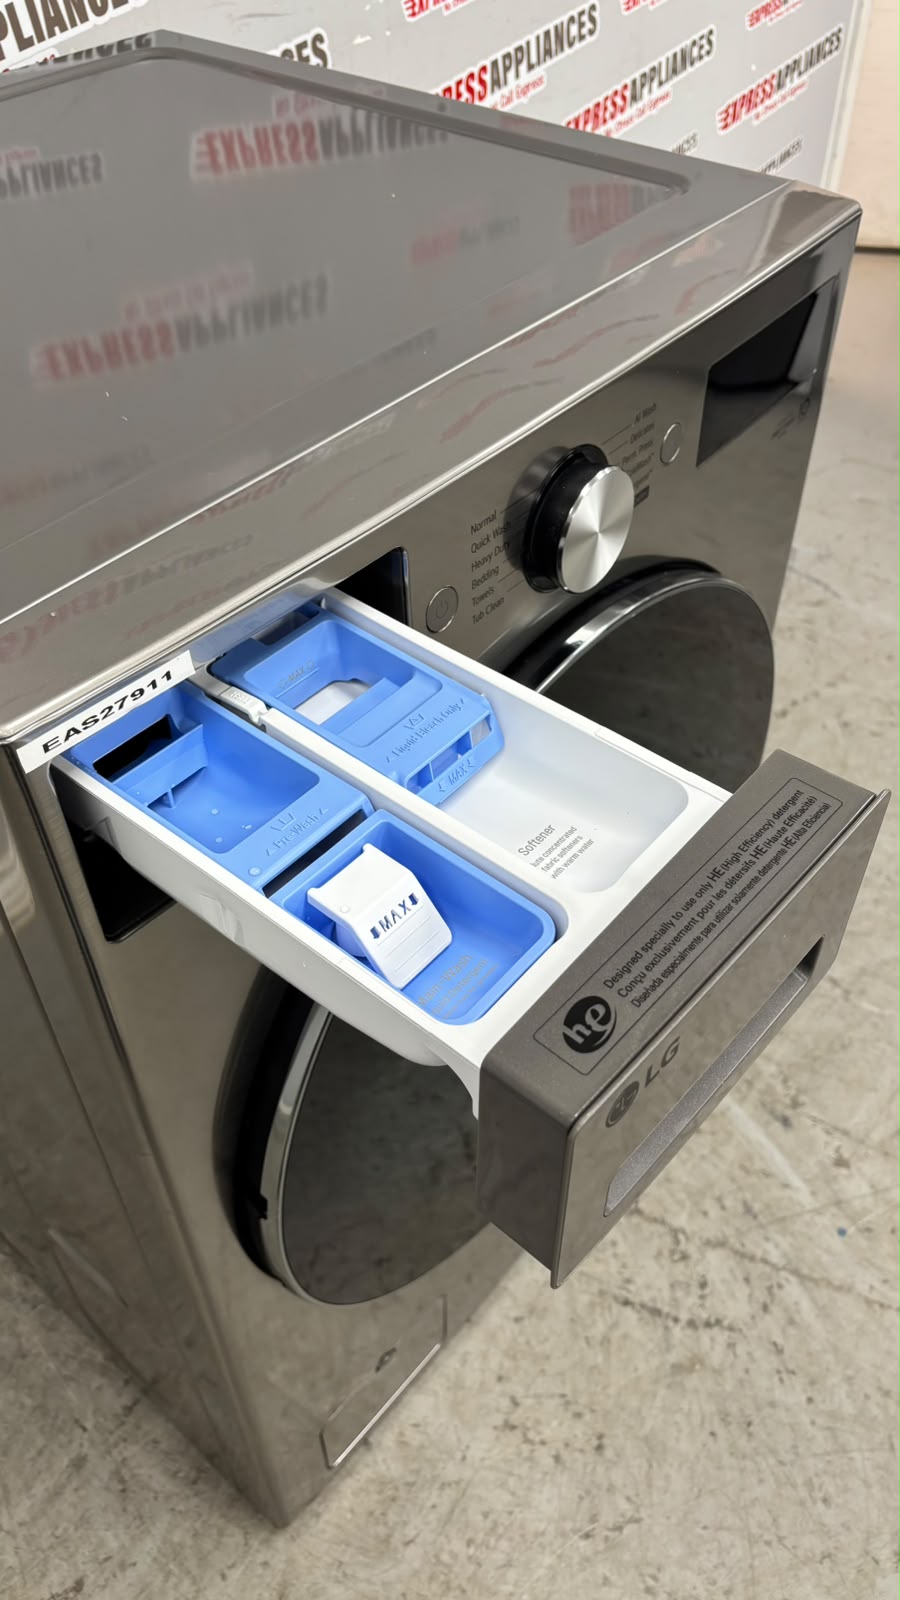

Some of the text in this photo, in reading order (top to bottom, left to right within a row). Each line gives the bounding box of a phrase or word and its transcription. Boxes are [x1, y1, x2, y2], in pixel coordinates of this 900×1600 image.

[470, 509, 497, 535] Normal
[471, 521, 511, 554] Quick Wash
[471, 552, 493, 573] Heavy
[471, 565, 499, 590] Bedding
[471, 585, 495, 607] Towels
[472, 597, 505, 624] Tub Clean
[42, 670, 173, 754] EAS27911
[415, 717, 444, 738] Bleach
[440, 702, 461, 718] Only
[447, 763, 468, 785] MAX
[272, 815, 319, 849] Pre-Wash
[518, 824, 556, 856] Softener
[542, 826, 578, 858] concentrated
[541, 835, 584, 872] fabric softeners
[551, 838, 595, 879] with warm water
[603, 950, 643, 989] Designed
[641, 919, 676, 953] specially
[671, 911, 684, 921] to
[681, 897, 698, 912] use
[695, 881, 714, 899] only
[738, 818, 776, 853] Efficiency)
[772, 789, 805, 820] detergent
[617, 970, 647, 998] Conçu
[644, 917, 699, 972] exclusivement
[696, 899, 716, 920] pour
[712, 887, 728, 901] les
[724, 859, 757, 890] détersifs
[783, 795, 818, 828] Efficacité)
[378, 899, 411, 933] MAX
[630, 977, 664, 1008] Diseñada
[660, 935, 704, 979] especialmente
[700, 921, 717, 938] para
[714, 903, 735, 924] utilizar
[731, 874, 761, 905] solamente
[757, 848, 788, 877] detergente
[562, 1002, 608, 1045] he
[644, 1036, 681, 1088] LG
